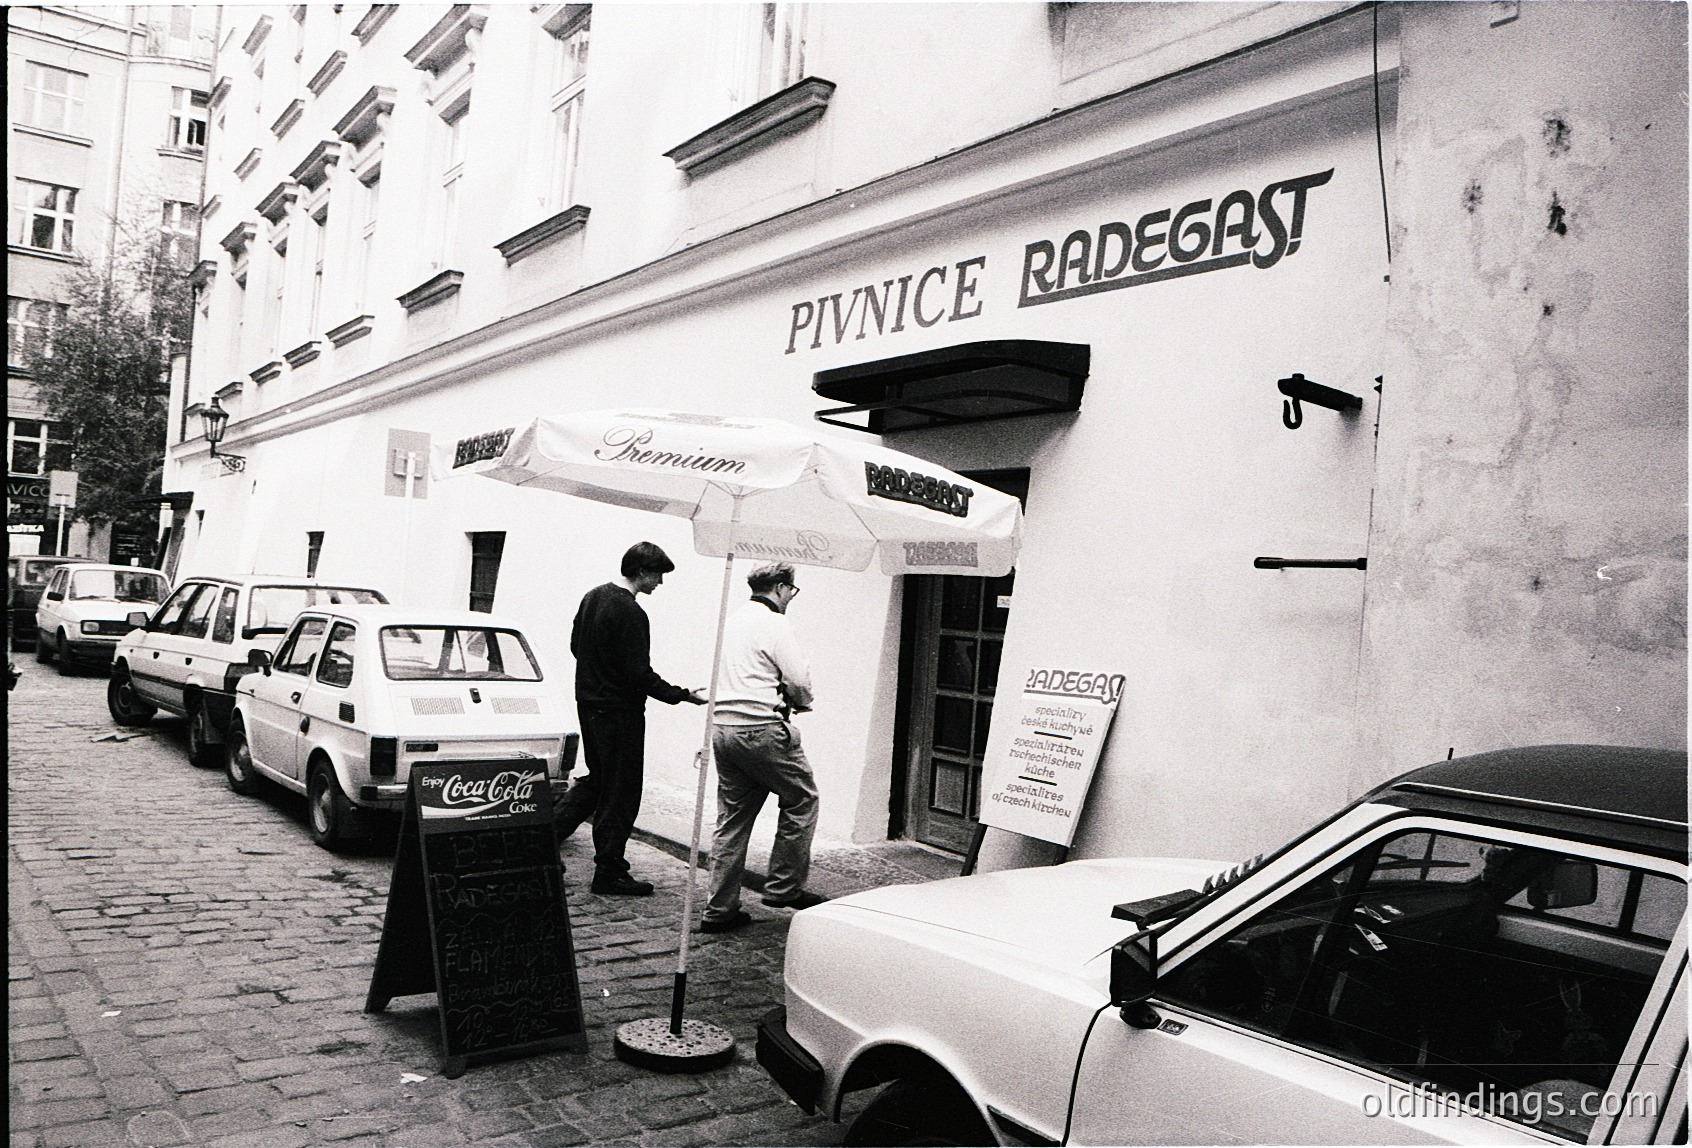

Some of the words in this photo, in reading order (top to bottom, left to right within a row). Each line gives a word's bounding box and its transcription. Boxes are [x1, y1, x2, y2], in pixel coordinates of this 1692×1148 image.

[785, 256, 986, 355] PIVNICE
[1017, 168, 1335, 308] RADEGAST
[594, 425, 748, 475] Premium
[864, 460, 974, 518] RADEGAST
[1035, 706, 1087, 722] speciality
[1014, 737, 1085, 757] spezialitäten
[1009, 748, 1082, 770] tschechischen
[1024, 762, 1056, 778] küche
[421, 776, 445, 789] Enjoy
[442, 770, 535, 805] Coca-Cola
[1006, 783, 1064, 802] specialites
[508, 801, 538, 814] Coke
[992, 792, 1004, 803] of
[1003, 795, 1031, 809] czech
[1031, 799, 1072, 818] kitchen
